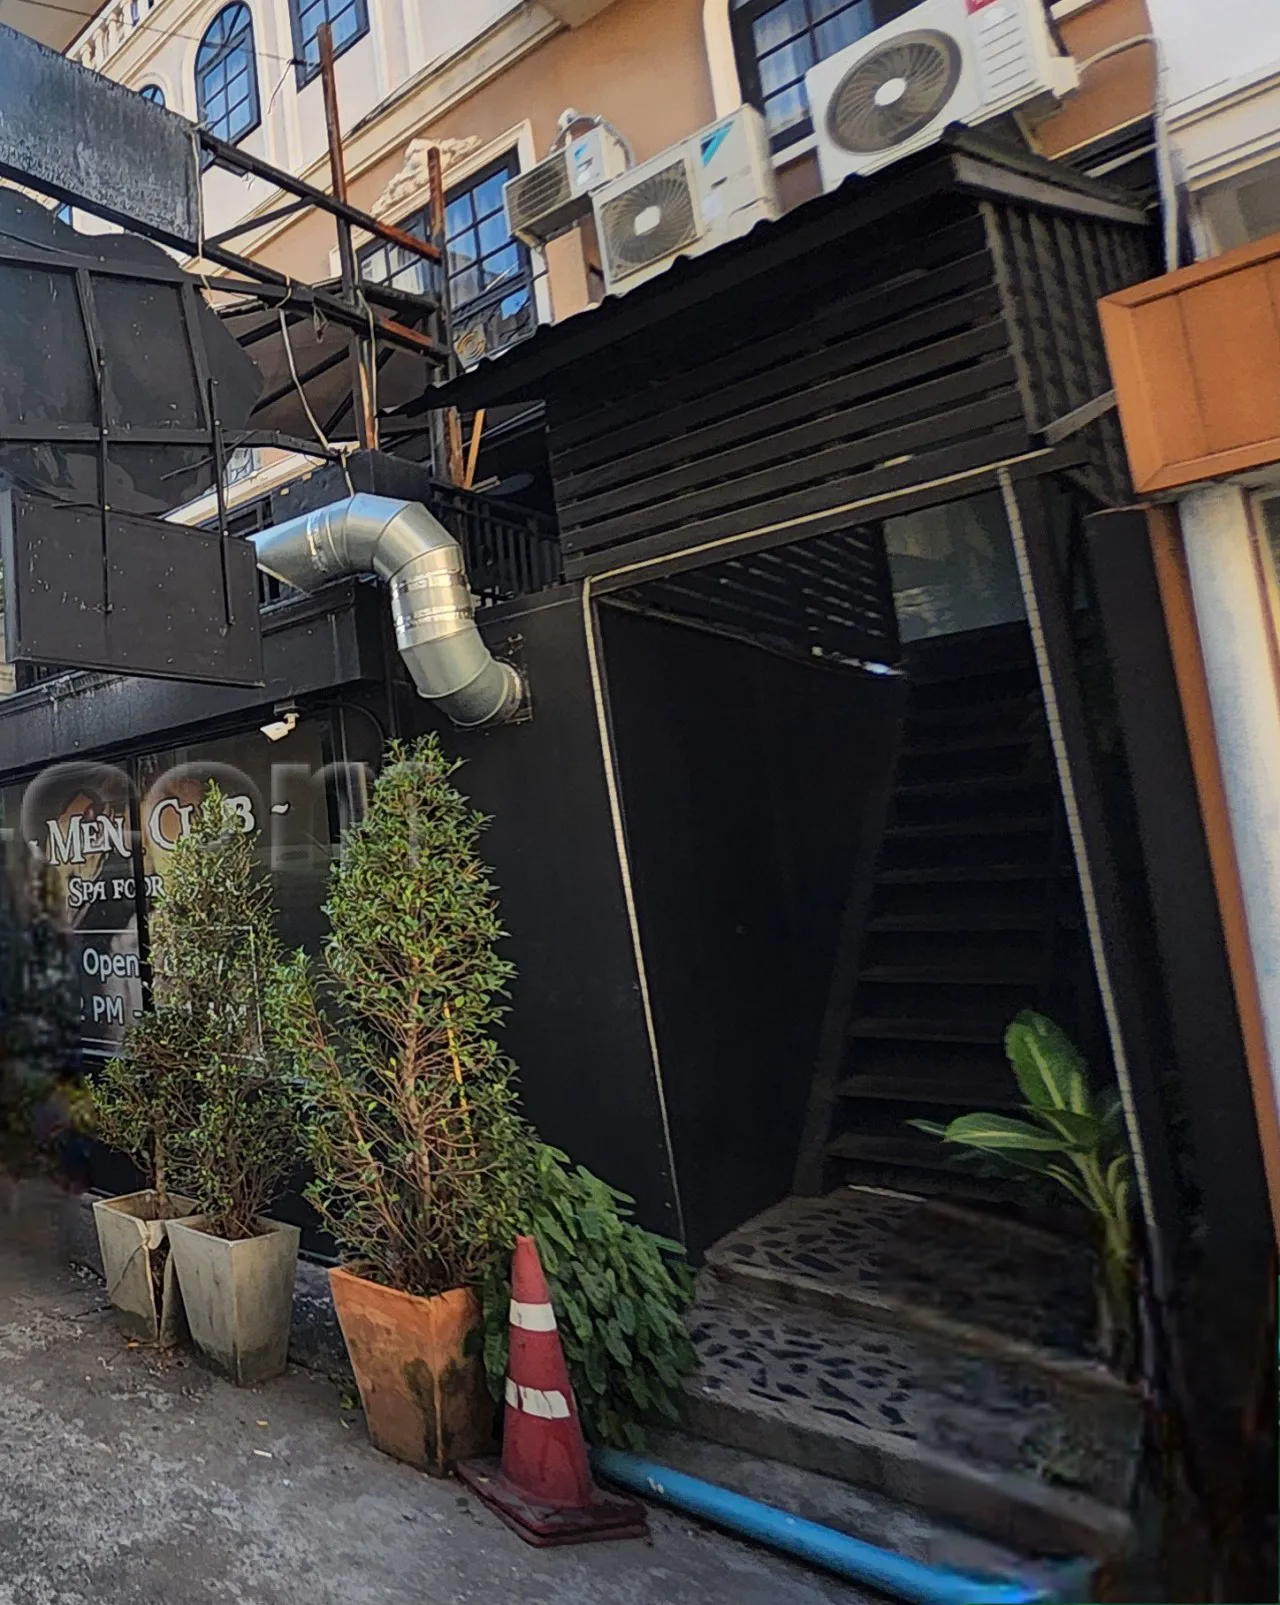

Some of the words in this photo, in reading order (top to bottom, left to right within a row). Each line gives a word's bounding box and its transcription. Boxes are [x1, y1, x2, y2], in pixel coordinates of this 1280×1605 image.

[46, 815, 132, 866] MEN
[69, 875, 107, 907] SPA
[83, 948, 140, 982] Open
[92, 995, 124, 1025] PM
